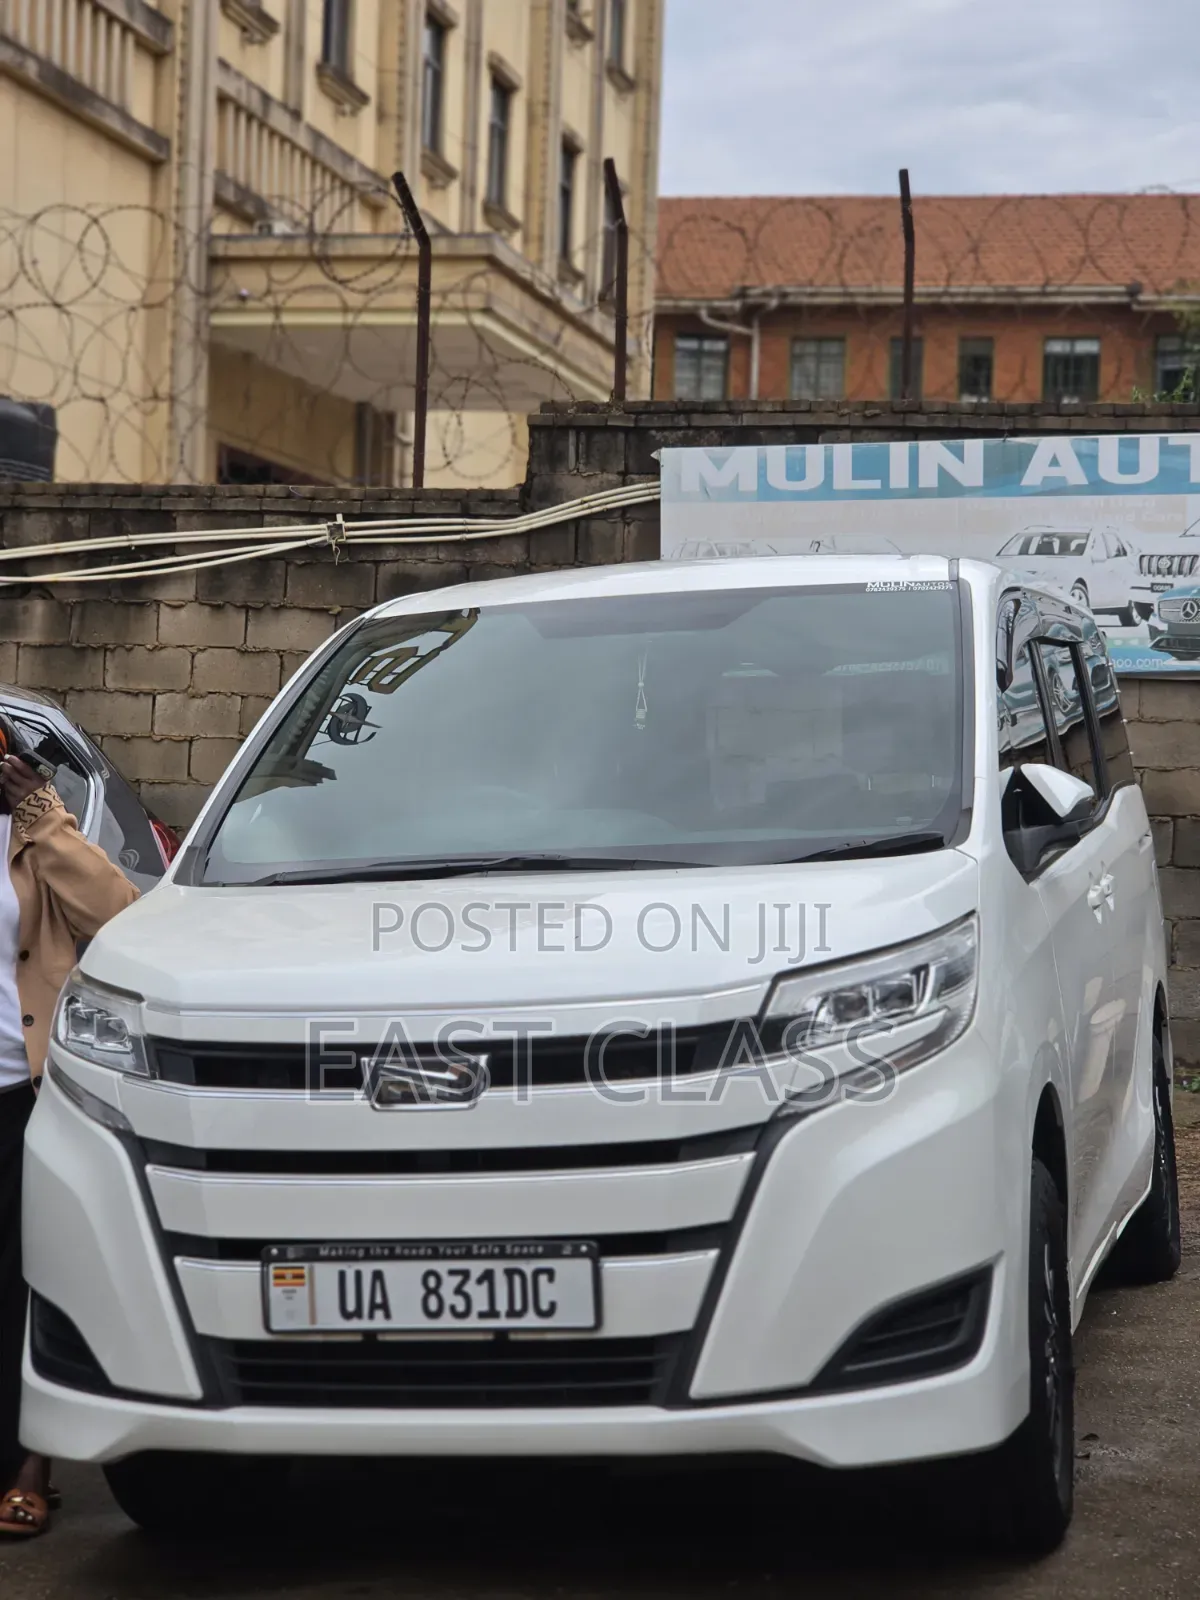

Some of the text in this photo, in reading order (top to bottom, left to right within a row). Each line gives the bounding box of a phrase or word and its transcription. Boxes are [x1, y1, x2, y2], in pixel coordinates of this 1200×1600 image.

[680, 438, 985, 492] MULIN
[338, 1267, 558, 1321] UA 831DC
